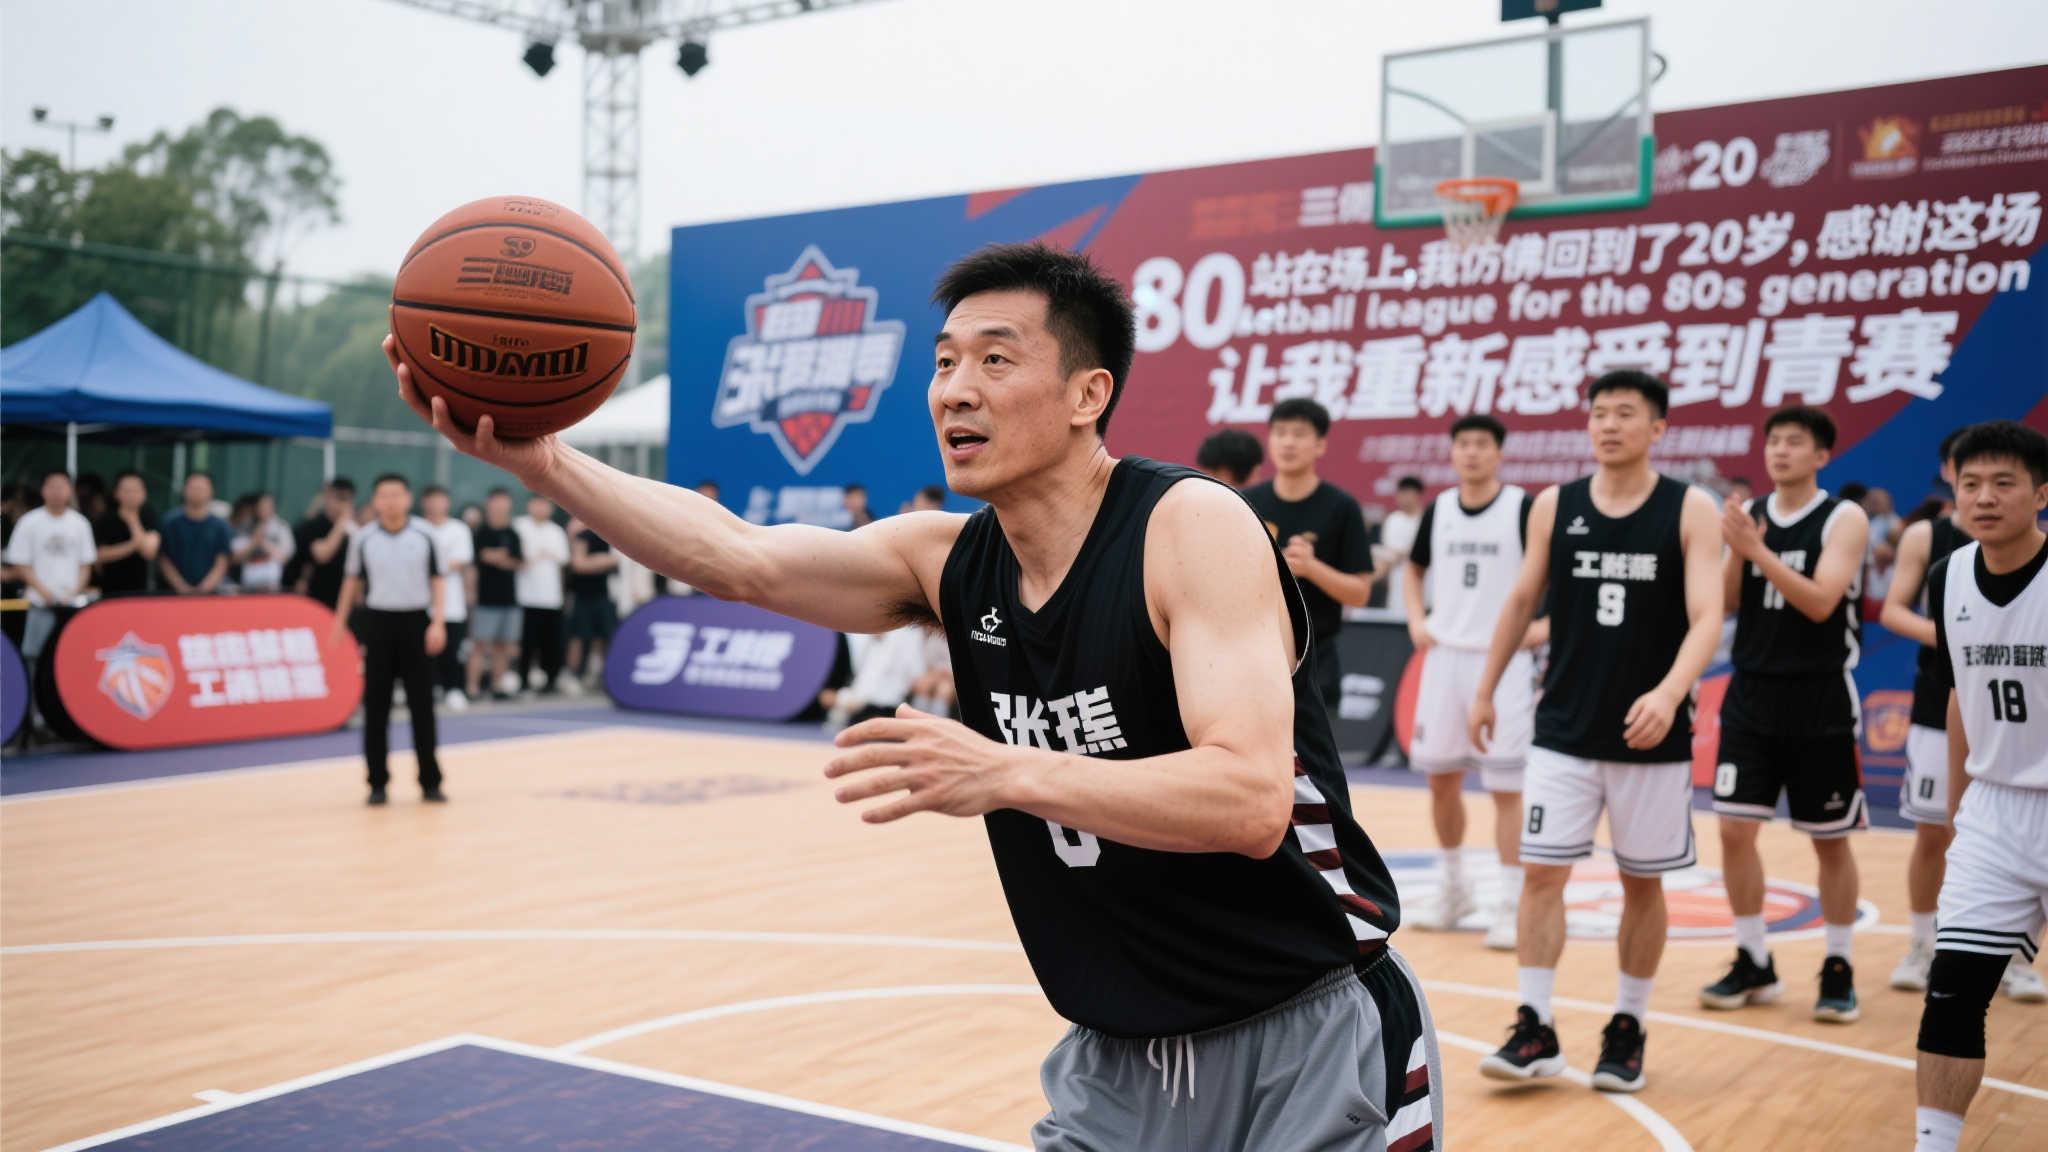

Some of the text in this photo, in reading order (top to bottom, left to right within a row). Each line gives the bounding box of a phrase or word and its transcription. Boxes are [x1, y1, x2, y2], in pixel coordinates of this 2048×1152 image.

[1688, 136, 1758, 190] 20
[1131, 252, 1245, 353] 80
[1366, 291, 1497, 336] league
[1509, 281, 1571, 321] for
[1581, 276, 1652, 317] the
[1662, 270, 1747, 313] 80s
[1758, 254, 2031, 317] generation
[1987, 678, 2028, 723] 18
